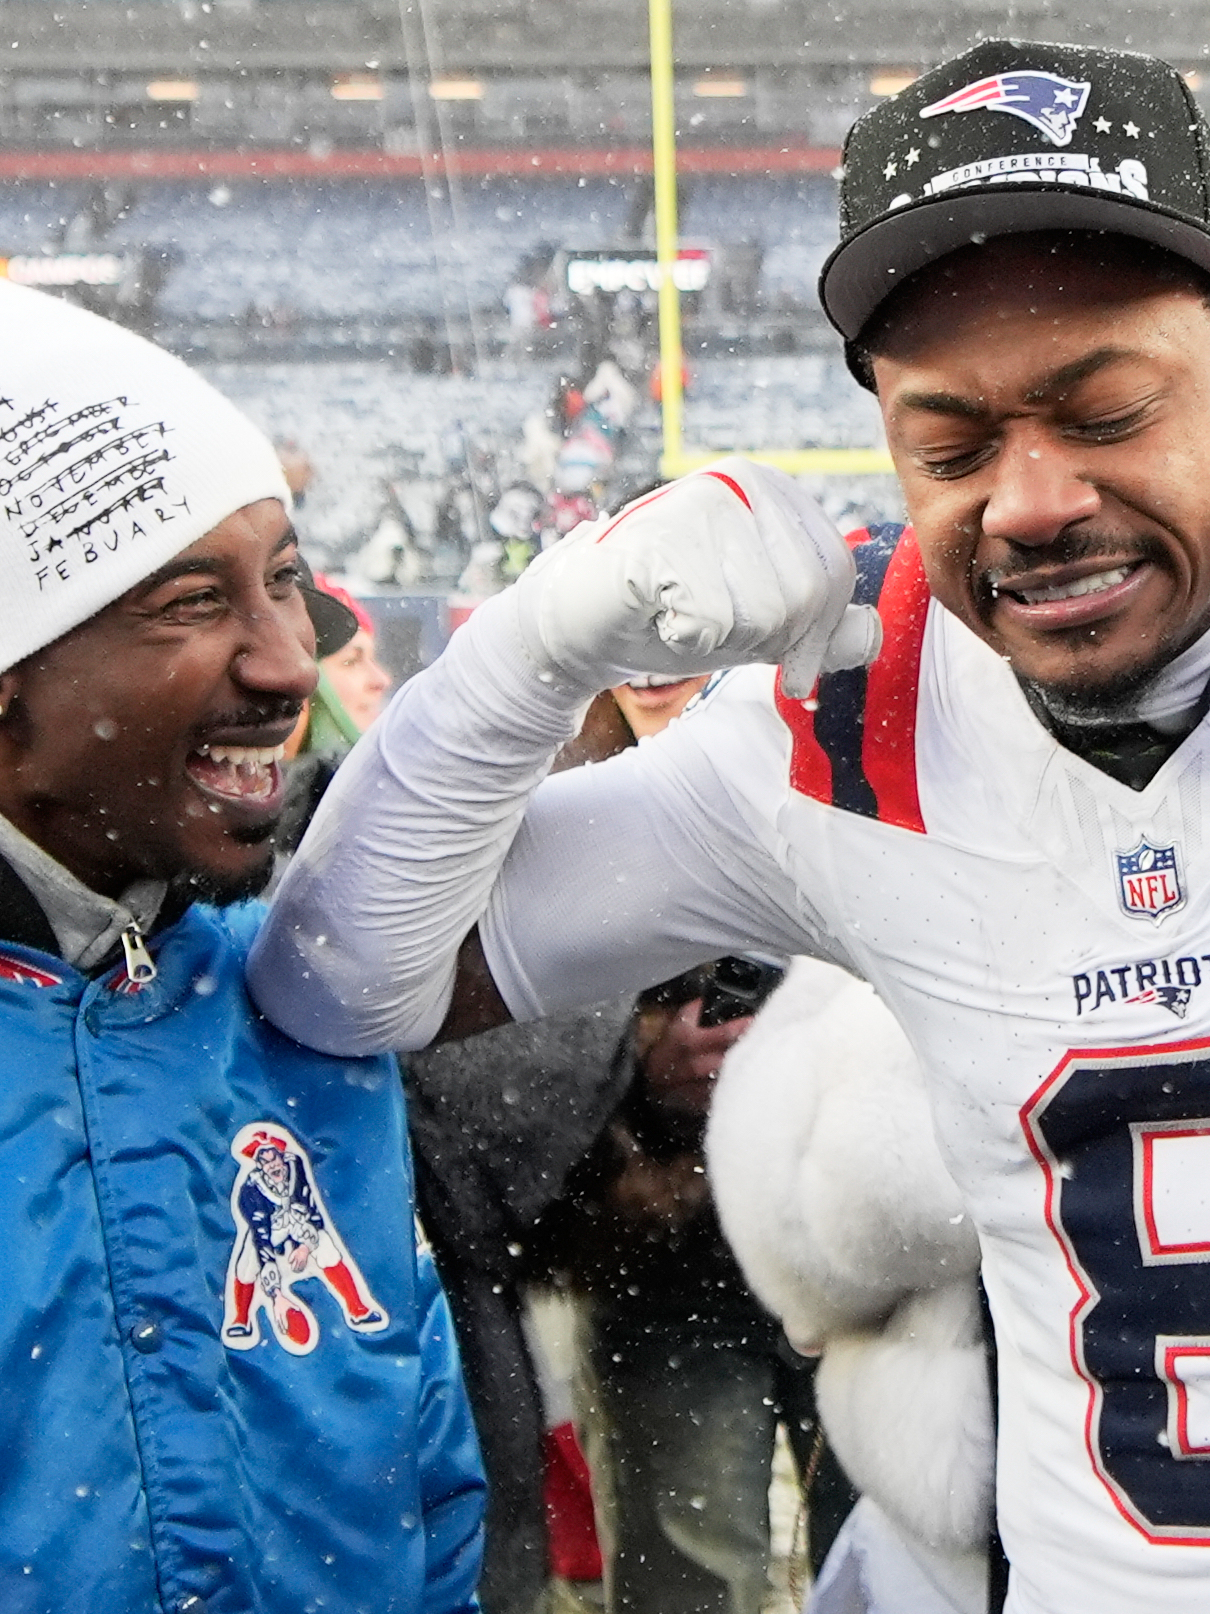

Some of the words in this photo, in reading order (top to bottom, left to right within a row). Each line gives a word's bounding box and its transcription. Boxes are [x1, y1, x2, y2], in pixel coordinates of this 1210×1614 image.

[952, 154, 1068, 182] CONFERENCE
[35, 495, 192, 592] FEBUARY
[1126, 873, 1176, 910] NFL
